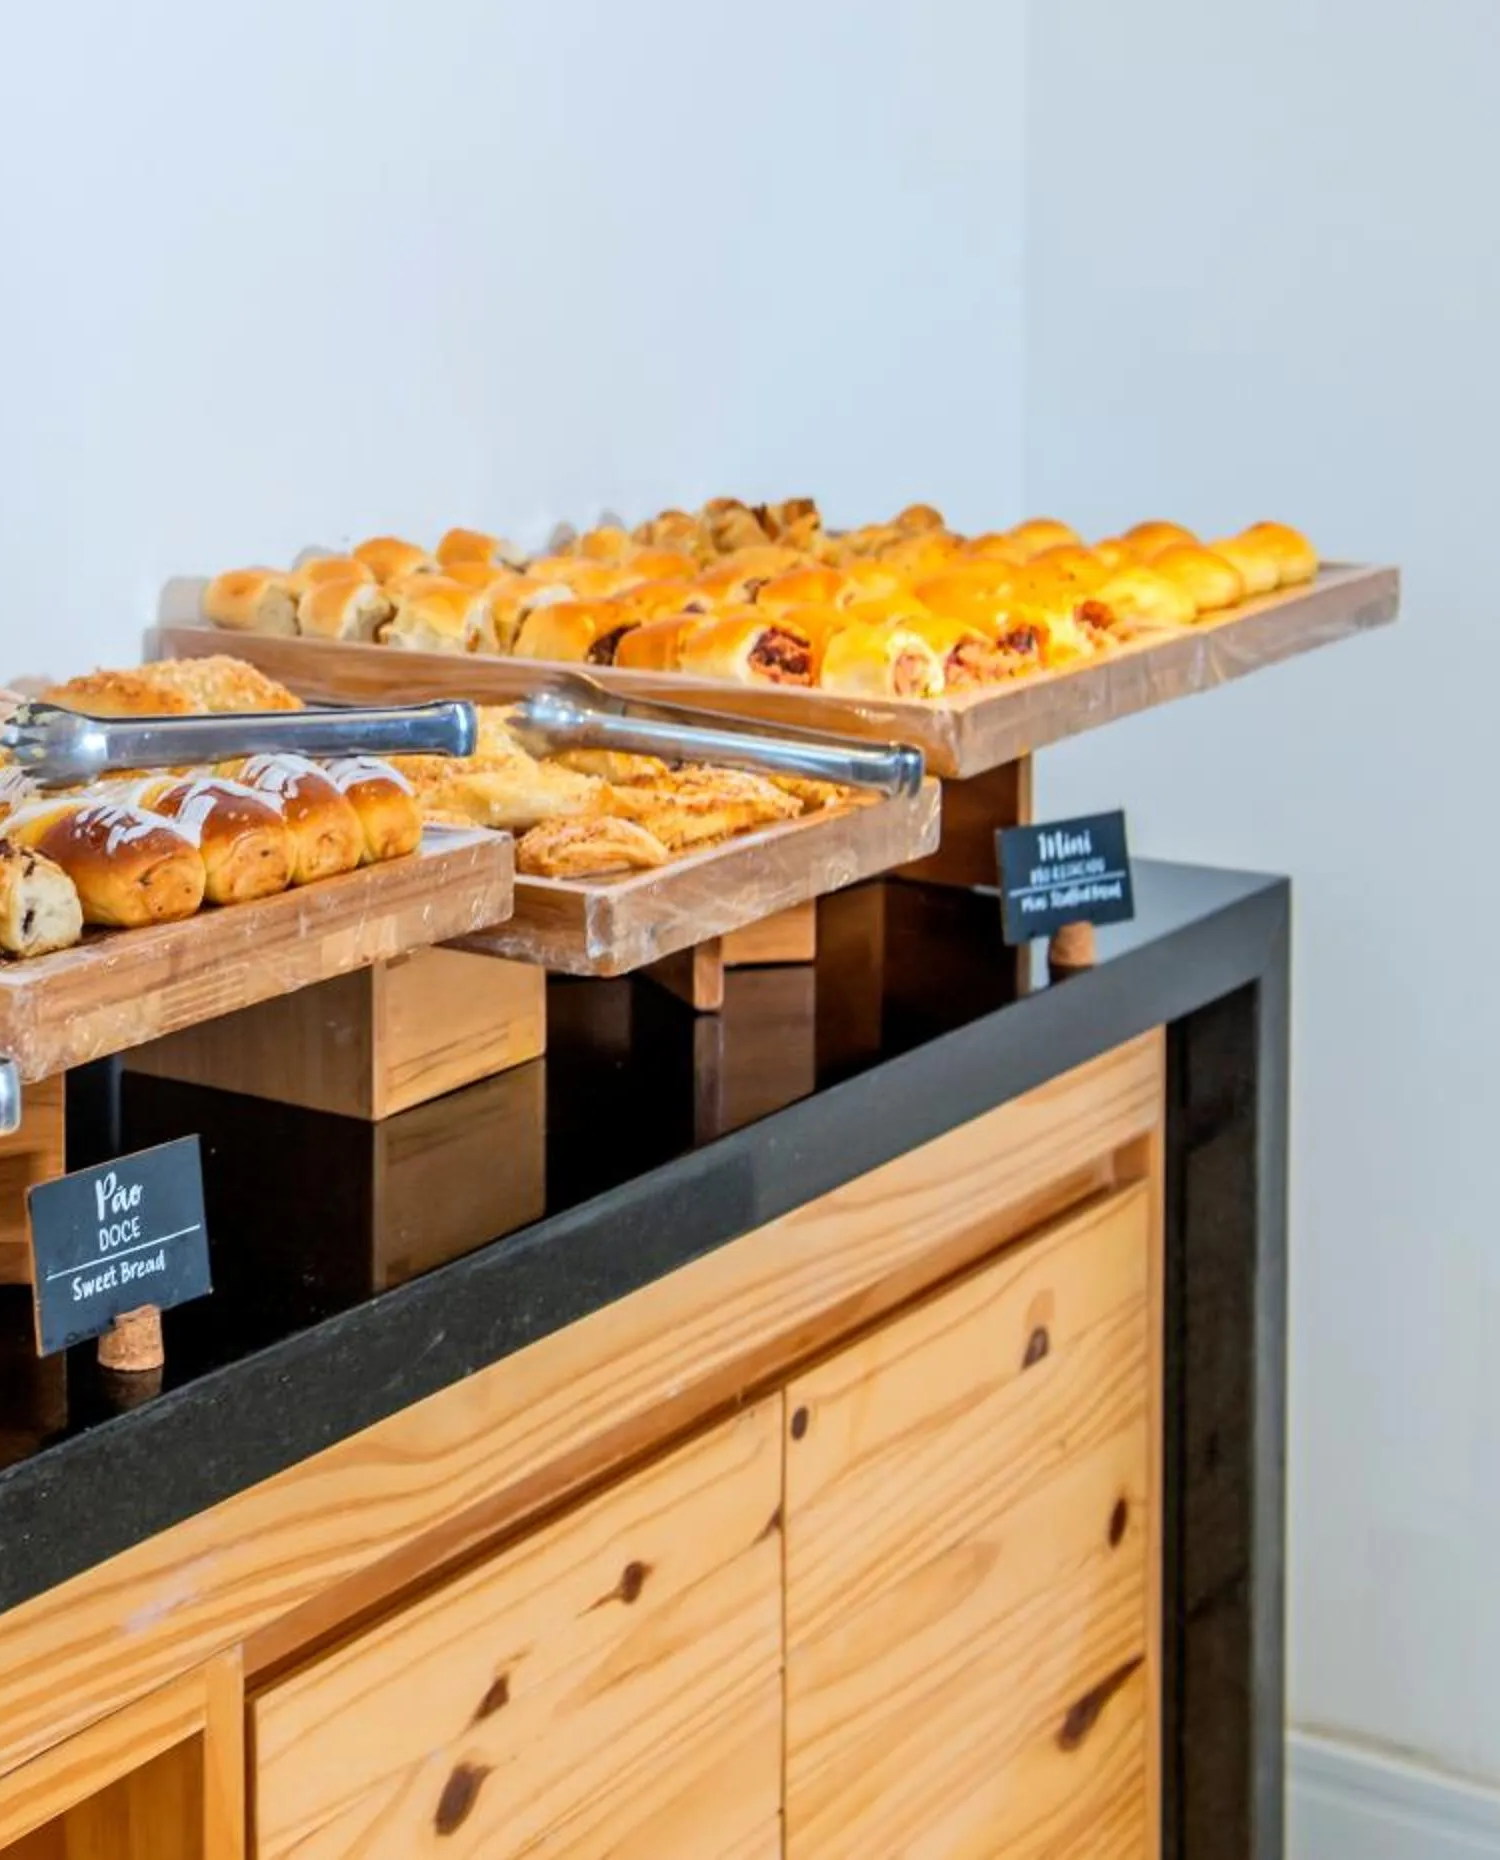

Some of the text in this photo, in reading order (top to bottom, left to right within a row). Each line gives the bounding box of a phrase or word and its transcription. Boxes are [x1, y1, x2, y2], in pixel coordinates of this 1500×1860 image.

[1037, 830, 1092, 861] Mini
[99, 1216, 141, 1252] DOCE
[72, 1249, 166, 1301] Sweet Bread
